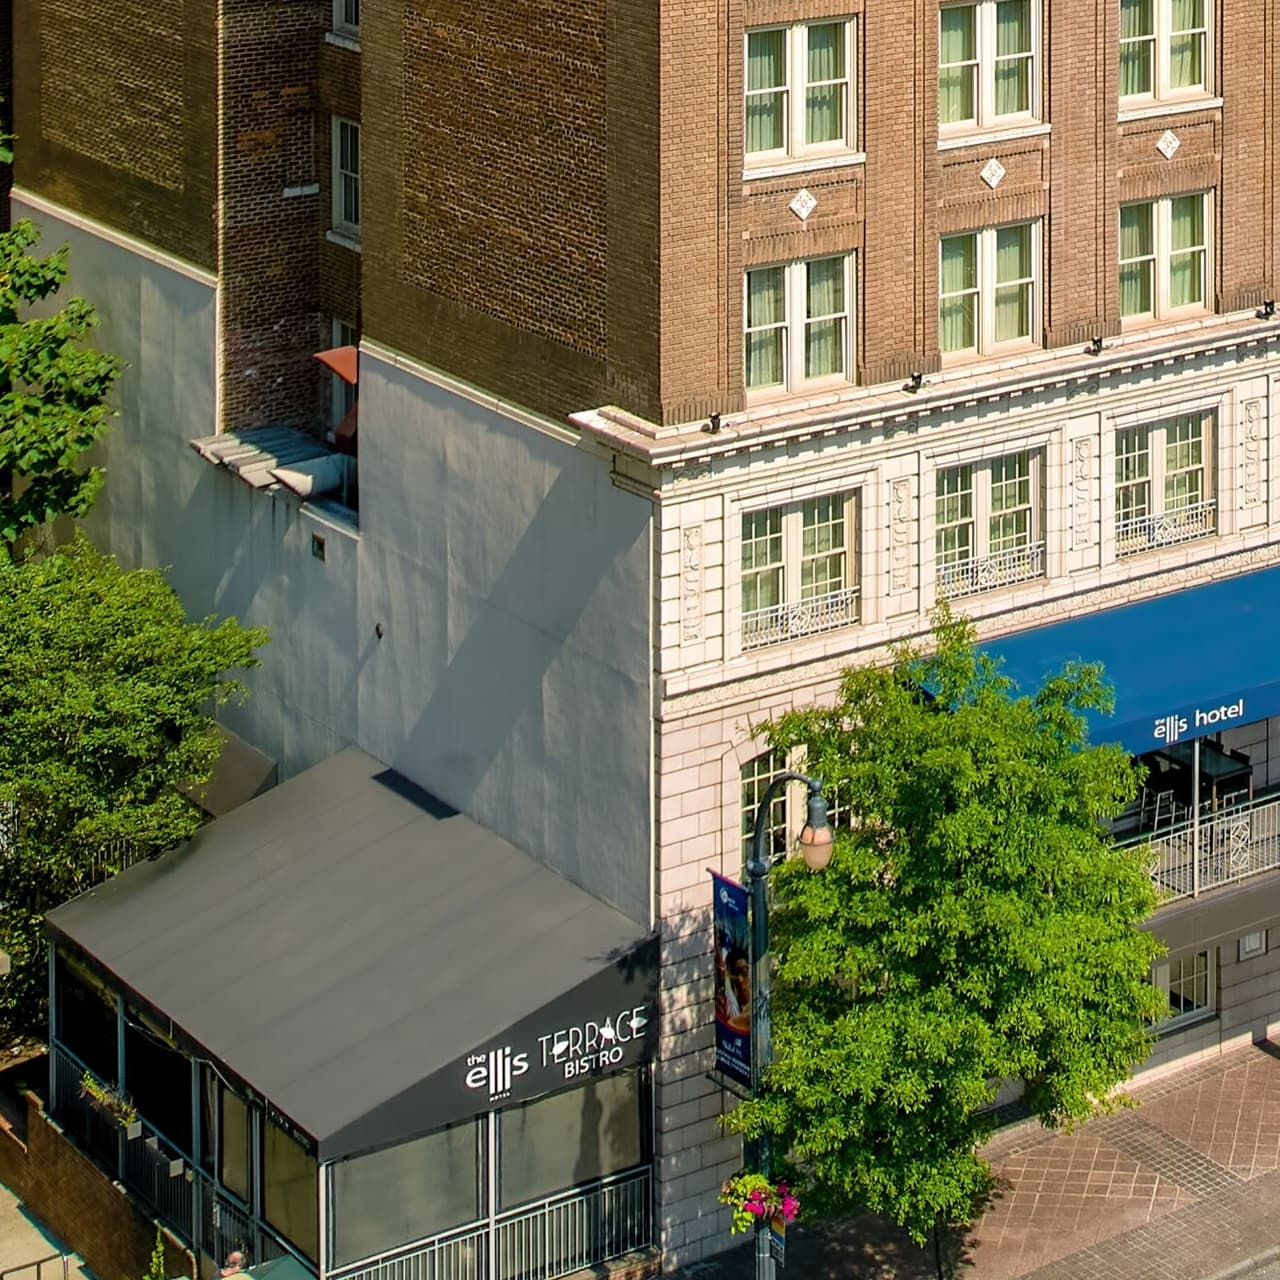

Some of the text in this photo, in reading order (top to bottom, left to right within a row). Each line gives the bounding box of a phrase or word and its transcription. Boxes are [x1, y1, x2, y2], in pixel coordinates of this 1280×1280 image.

[1153, 698, 1244, 744] ellis hotel
[466, 1053, 487, 1067] the
[537, 1006, 648, 1068] TERRACE
[465, 1046, 529, 1095] ellis
[564, 1047, 623, 1079] BISTRO
